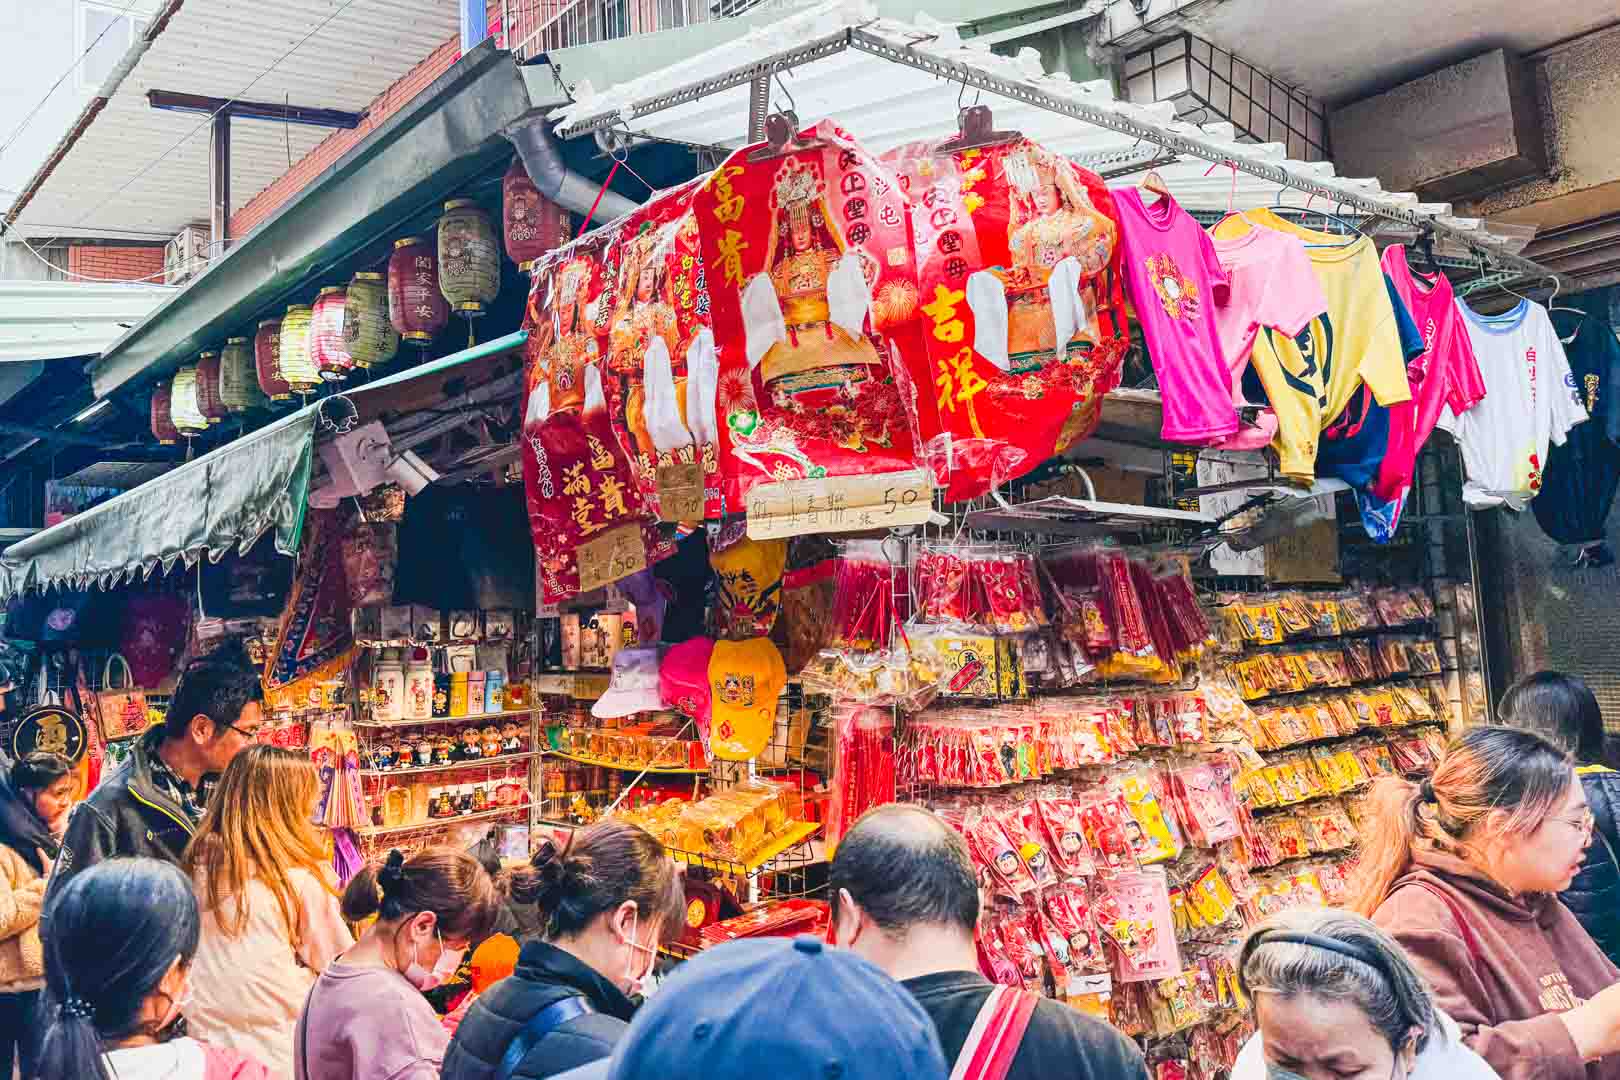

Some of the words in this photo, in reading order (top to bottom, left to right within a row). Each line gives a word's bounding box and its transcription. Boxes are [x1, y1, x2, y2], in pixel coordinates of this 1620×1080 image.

[704, 165, 749, 288] 富貴
[839, 150, 872, 246] 天上聖母
[673, 255, 695, 310] 白沙屯
[921, 283, 989, 439] 吉祥
[562, 461, 609, 537] 滿堂
[586, 433, 628, 520] 富貴
[884, 487, 918, 515] 50
